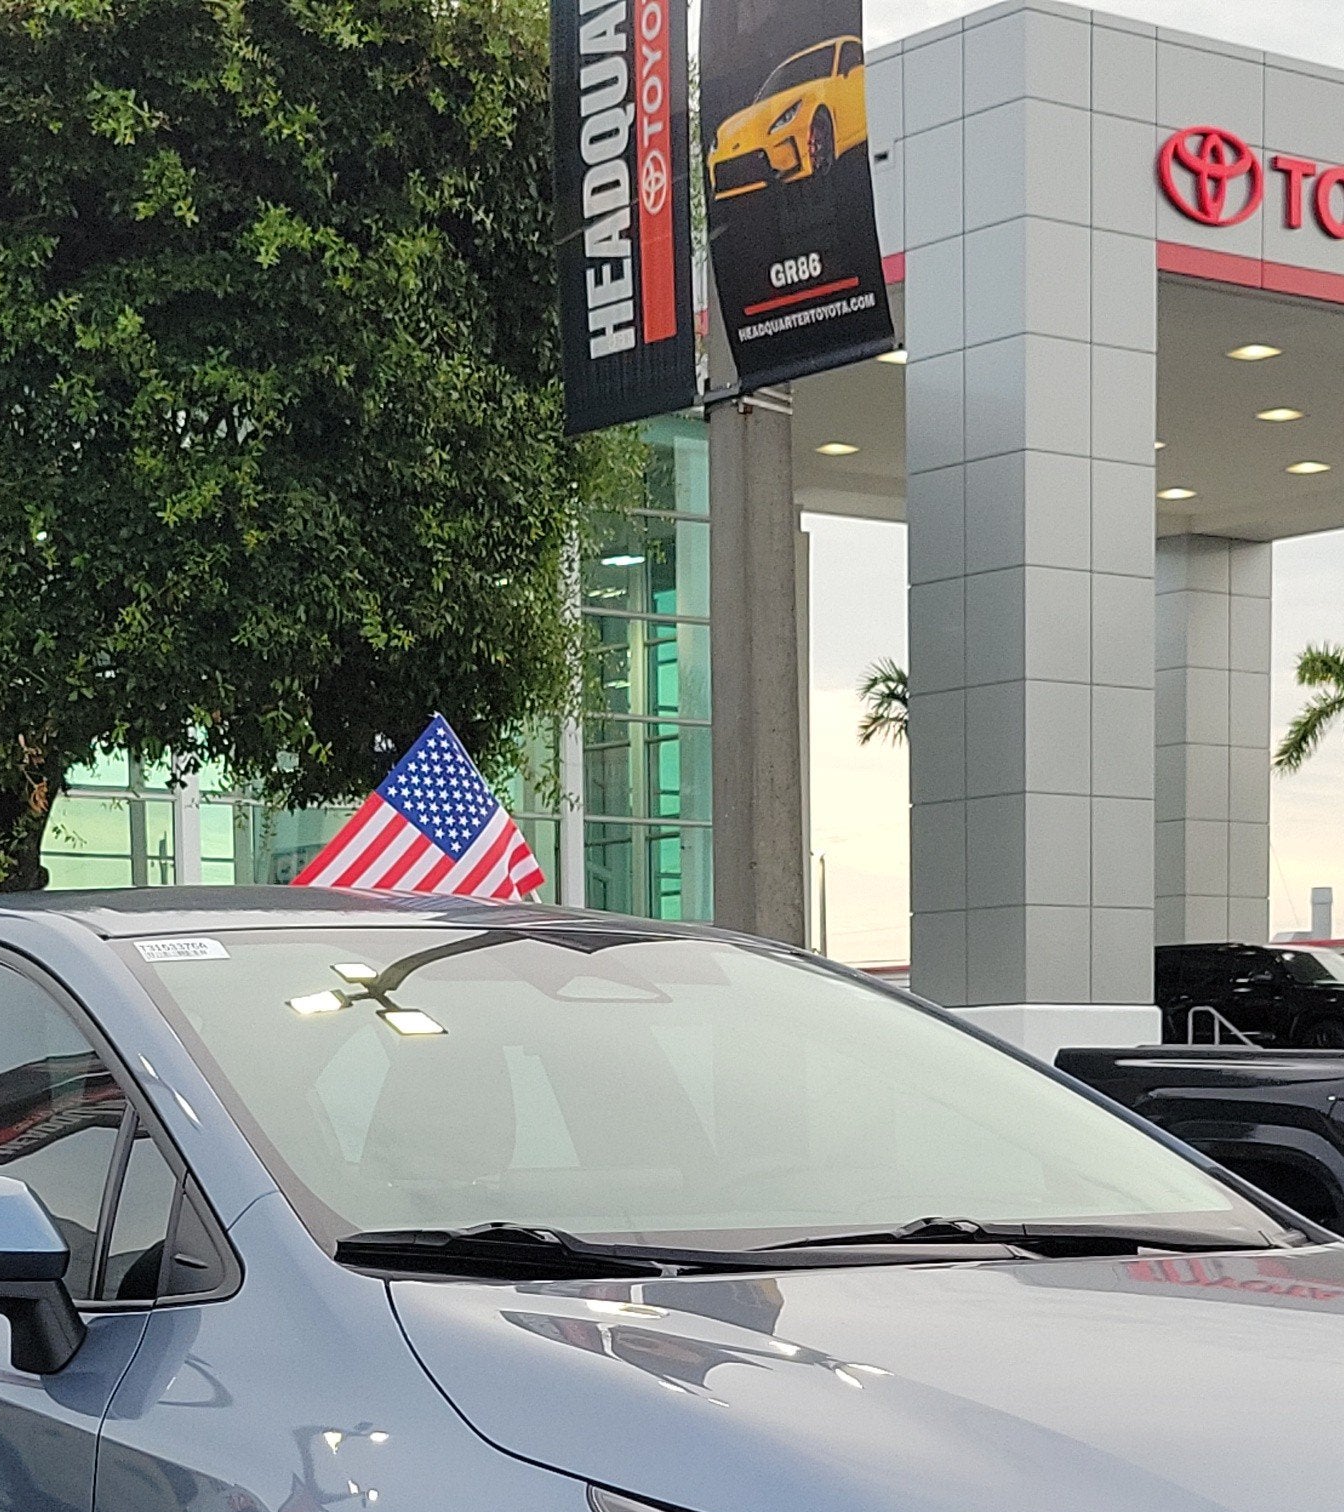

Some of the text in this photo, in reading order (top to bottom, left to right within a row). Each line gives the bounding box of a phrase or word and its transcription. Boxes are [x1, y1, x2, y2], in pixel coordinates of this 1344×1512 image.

[641, 0, 664, 148] TOYO
[579, 0, 636, 360] HEADQUA
[738, 293, 876, 342] HEADQUARTERTOYOTA.COM
[769, 252, 823, 289] GR86
